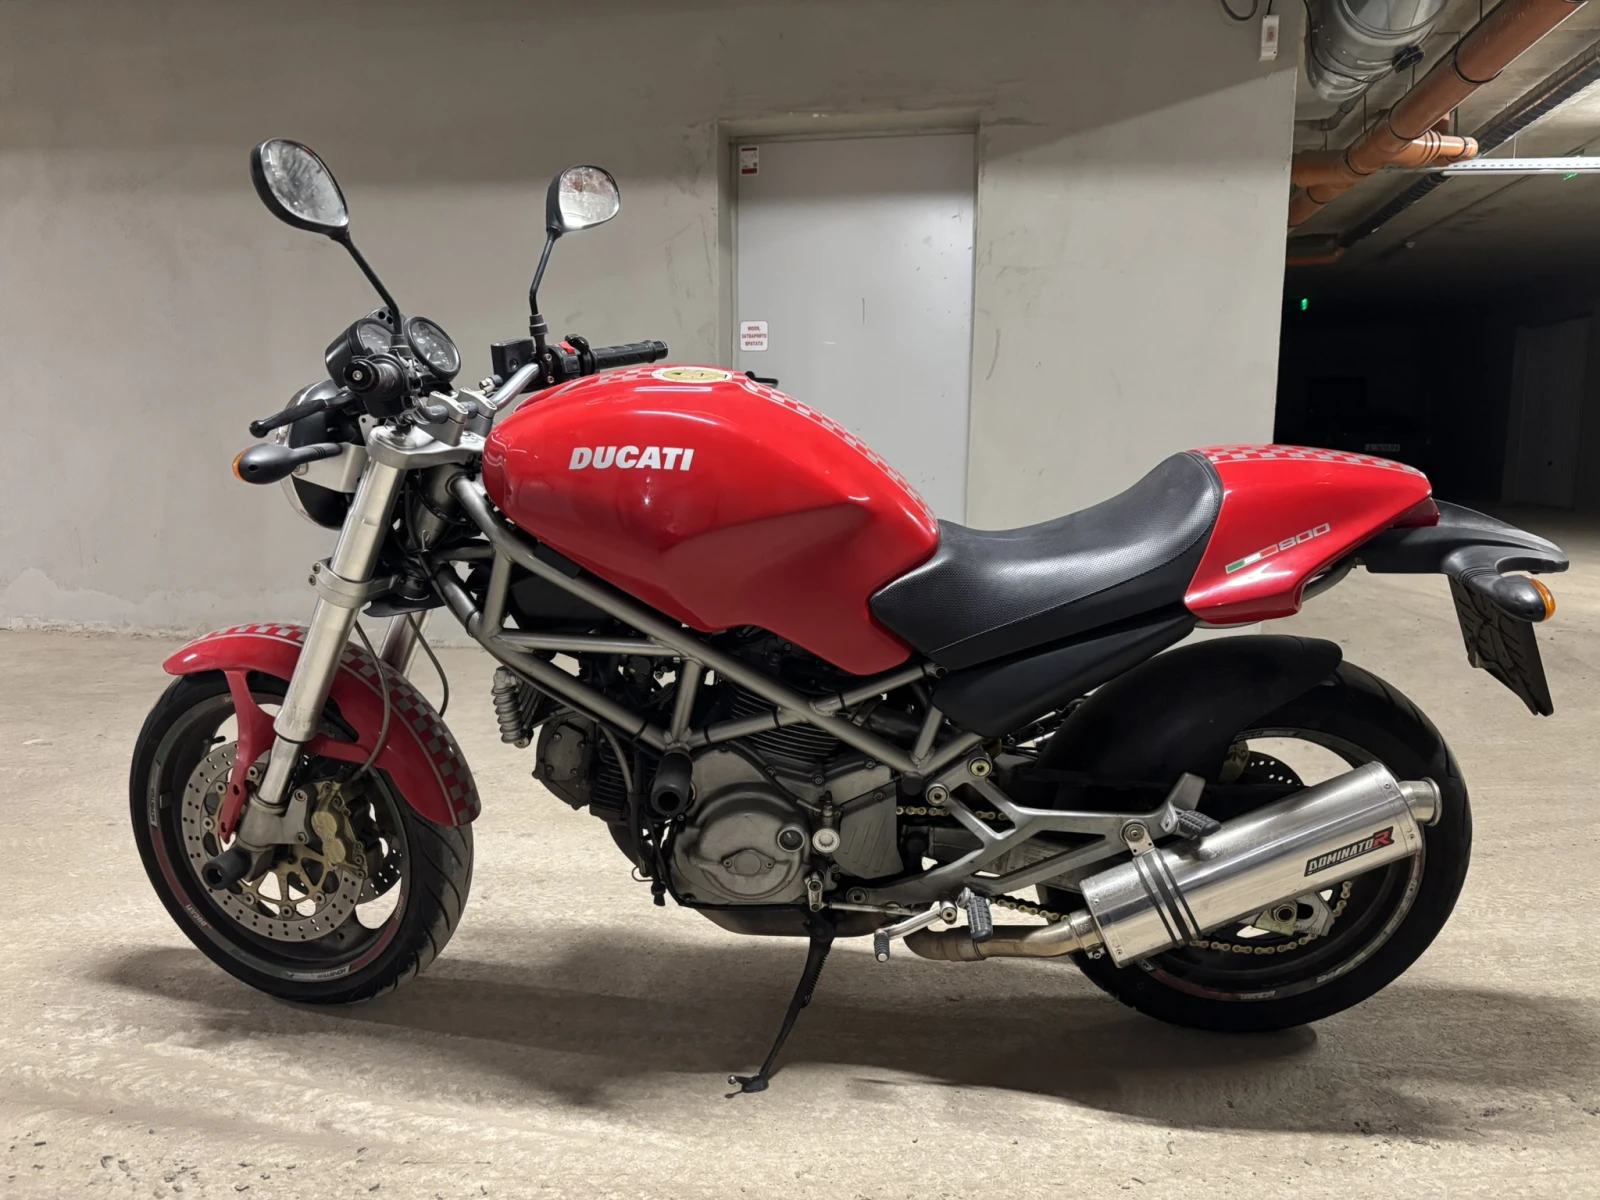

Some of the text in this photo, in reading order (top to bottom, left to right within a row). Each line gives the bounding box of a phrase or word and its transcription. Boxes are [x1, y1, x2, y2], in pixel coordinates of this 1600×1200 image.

[568, 445, 694, 471] DUCATI
[1278, 522, 1331, 551] 800
[1307, 830, 1390, 872] DOMINATOR
